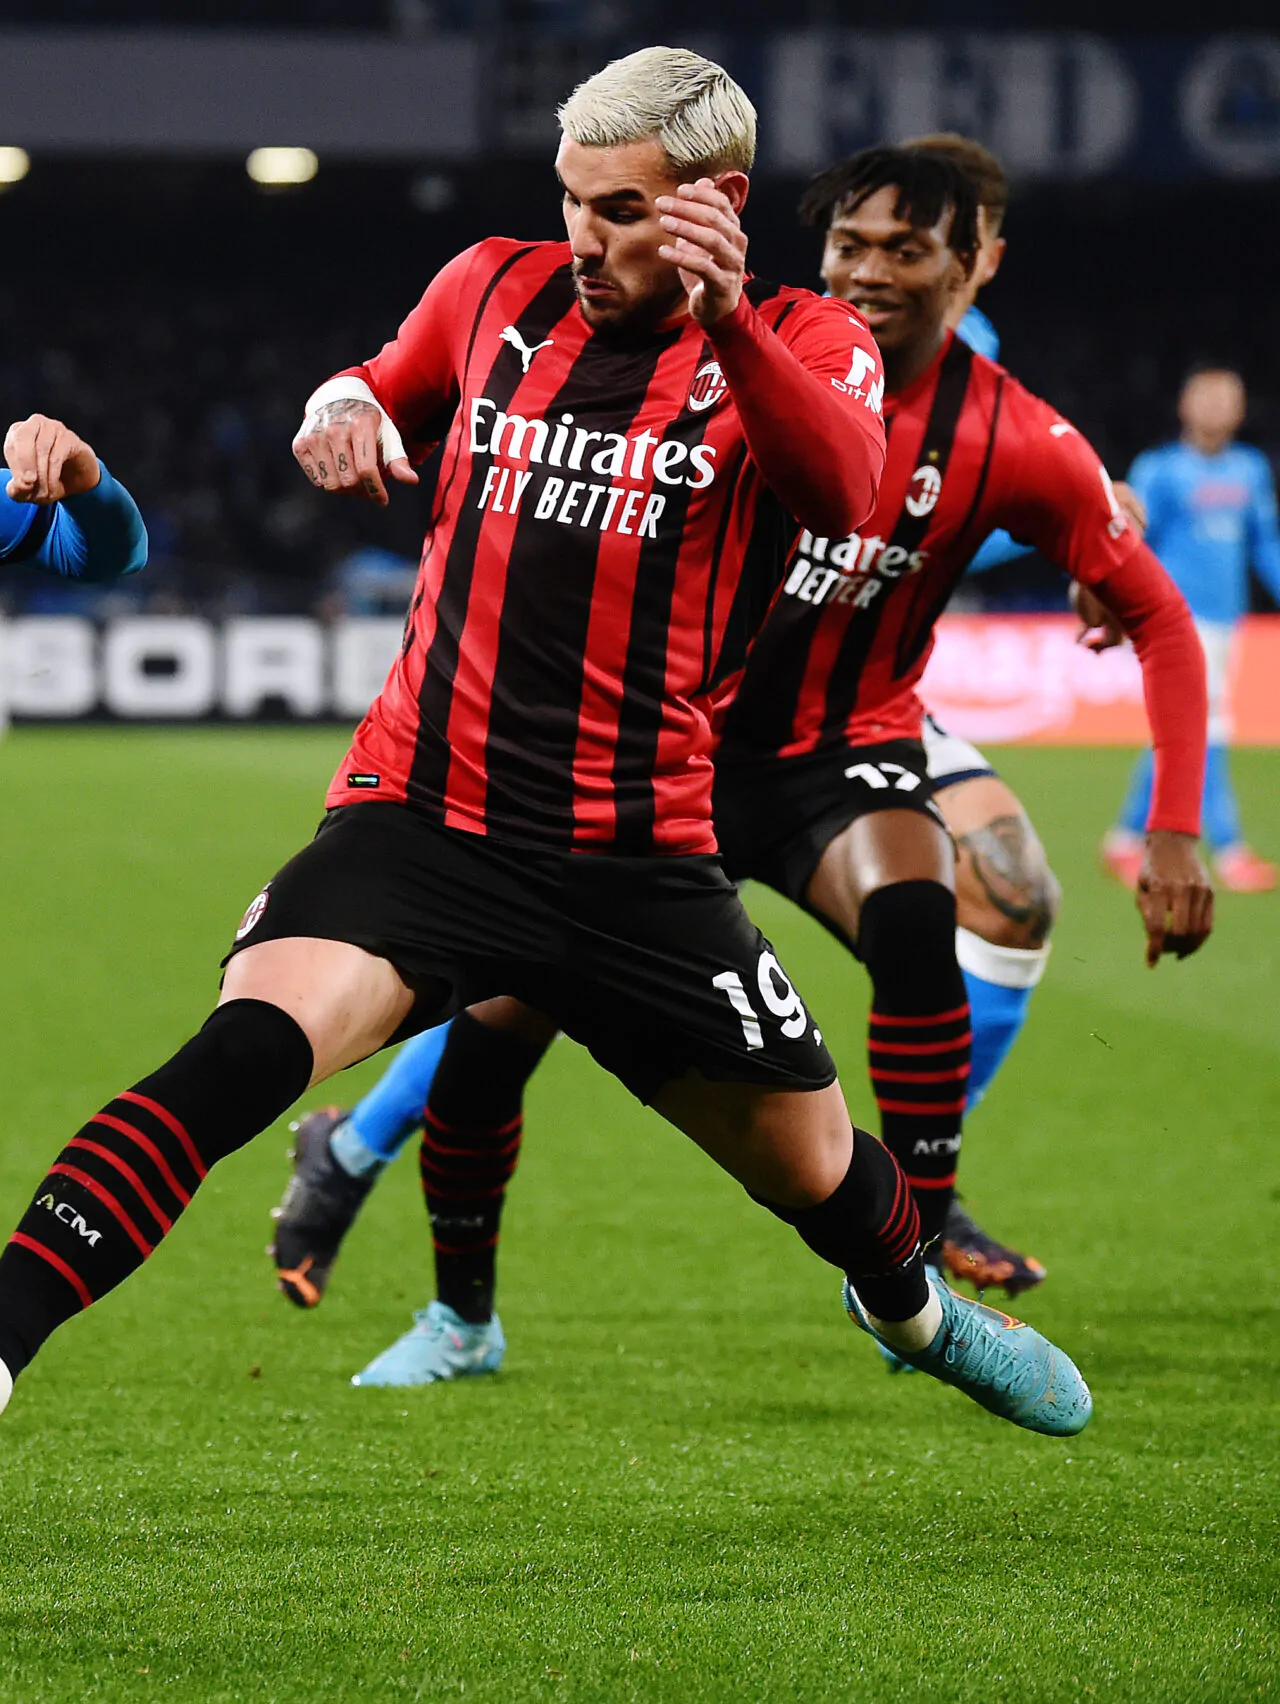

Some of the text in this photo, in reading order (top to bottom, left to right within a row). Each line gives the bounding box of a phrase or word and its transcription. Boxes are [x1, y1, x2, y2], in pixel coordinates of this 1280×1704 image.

[468, 396, 717, 489] Emirates
[477, 465, 667, 539] FLY BETTER
[844, 762, 922, 792] 17
[712, 950, 807, 1051] 19
[35, 1193, 104, 1248] ACM
